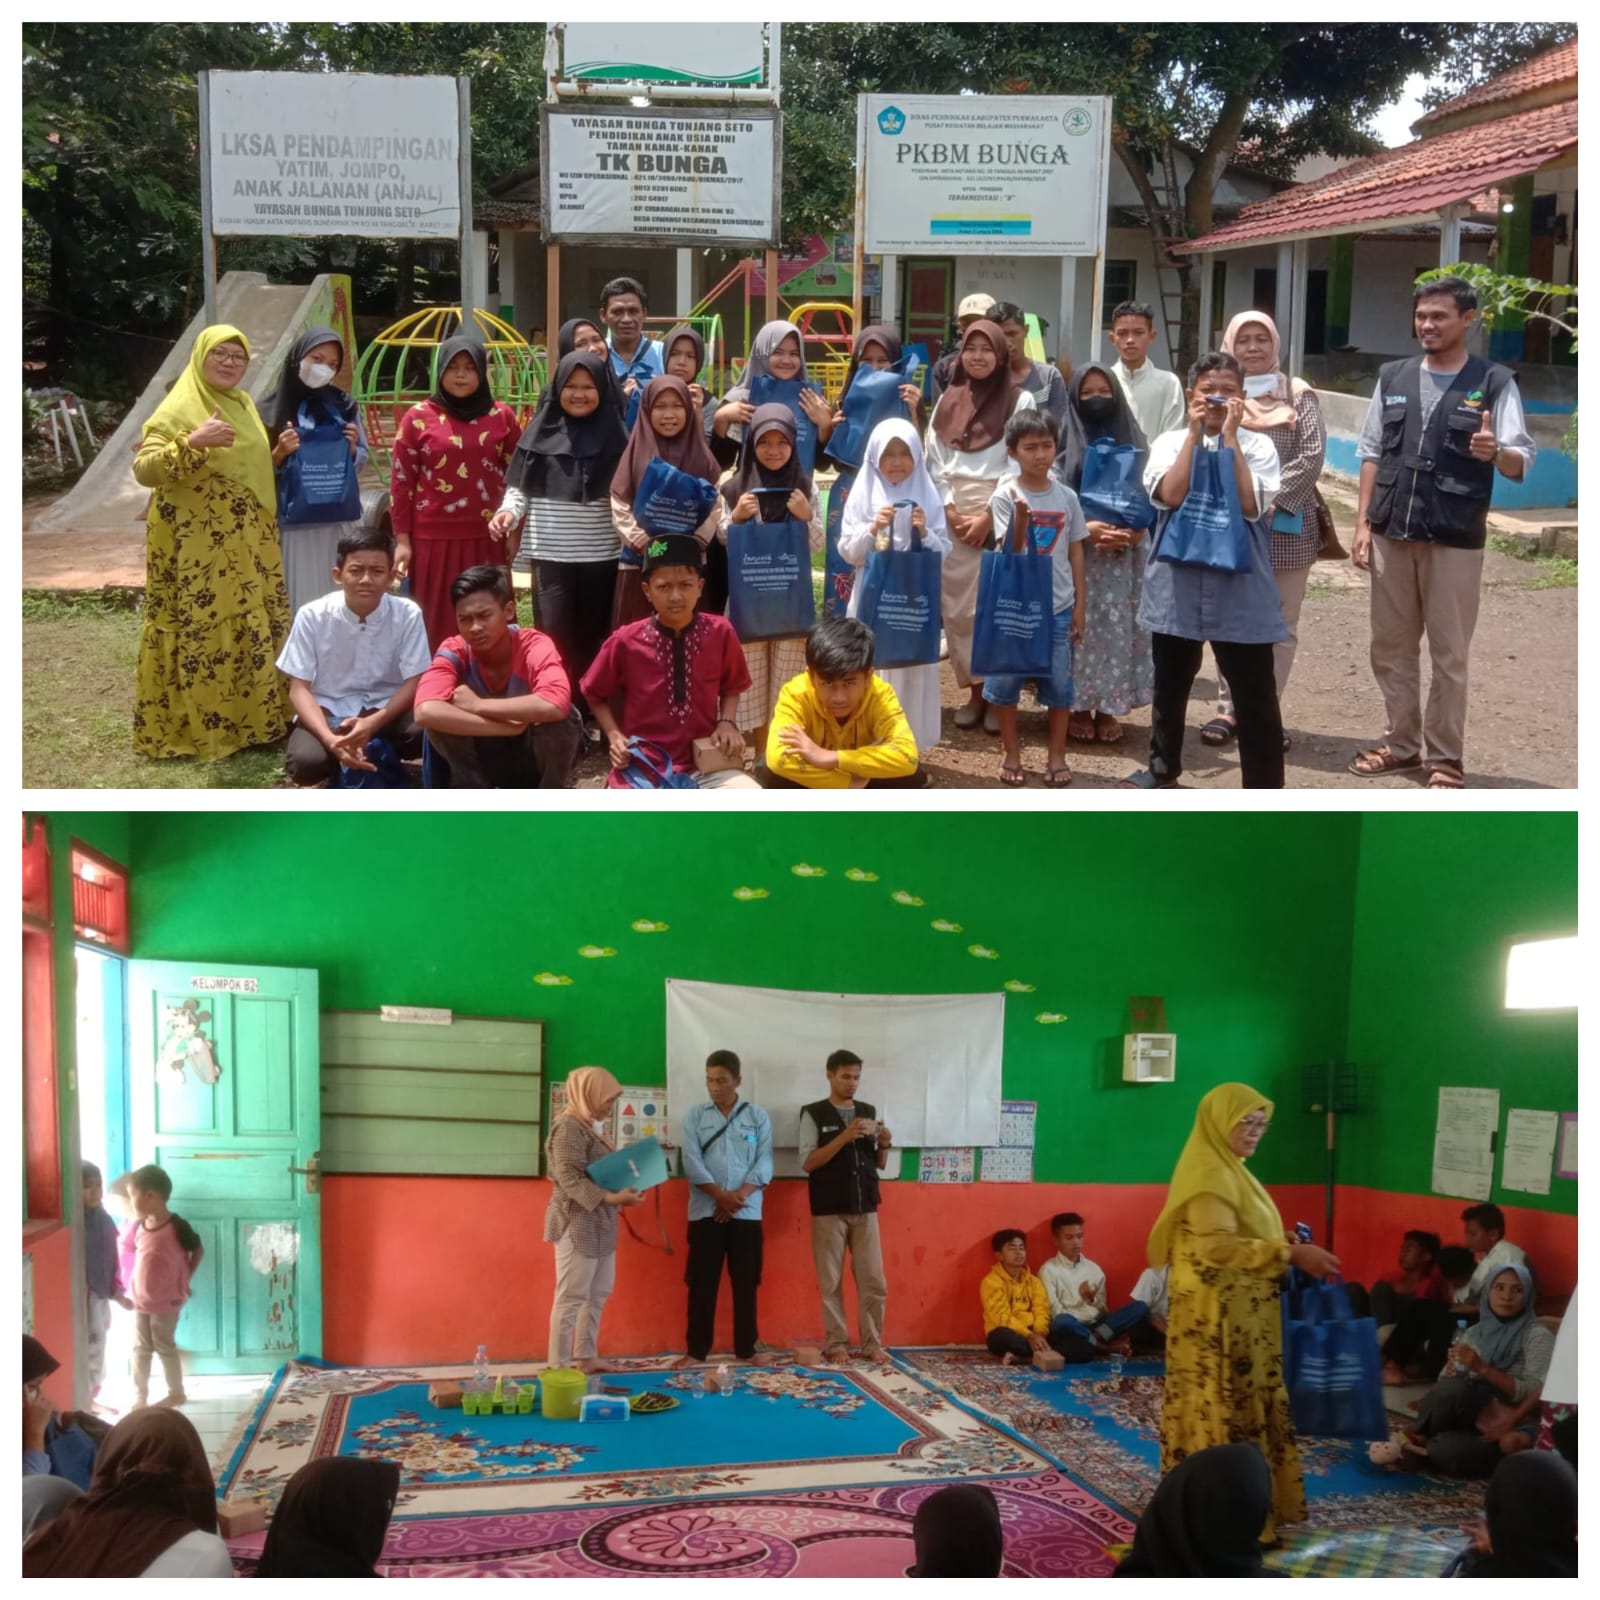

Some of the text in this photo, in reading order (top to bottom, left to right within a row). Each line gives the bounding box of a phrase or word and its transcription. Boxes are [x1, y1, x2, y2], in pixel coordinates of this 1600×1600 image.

[572, 118, 753, 133] YAYASAN BUNGA TUNJANG SETO
[589, 131, 736, 143] PENDIDIKAN ANAK USIA DINI
[221, 133, 453, 161] LKSA PENDAMPINGAN
[607, 142, 718, 154] TAMAN KANAK-KANAK
[896, 143, 1070, 165] PKBM BUNGA
[276, 160, 405, 182] YATIM, JOMPO,
[596, 153, 728, 174] TK BUNGA
[233, 180, 443, 204] ANAK JALANAN (ANJAL)
[254, 203, 421, 218] YAYASAN BUNGA TUNJUNG SETO
[192, 977, 256, 992] KELOMPOK B2
[922, 1156, 933, 1168] 13
[949, 1156, 959, 1169] 15
[921, 1170, 932, 1182] 17
[949, 1170, 958, 1182] 19
